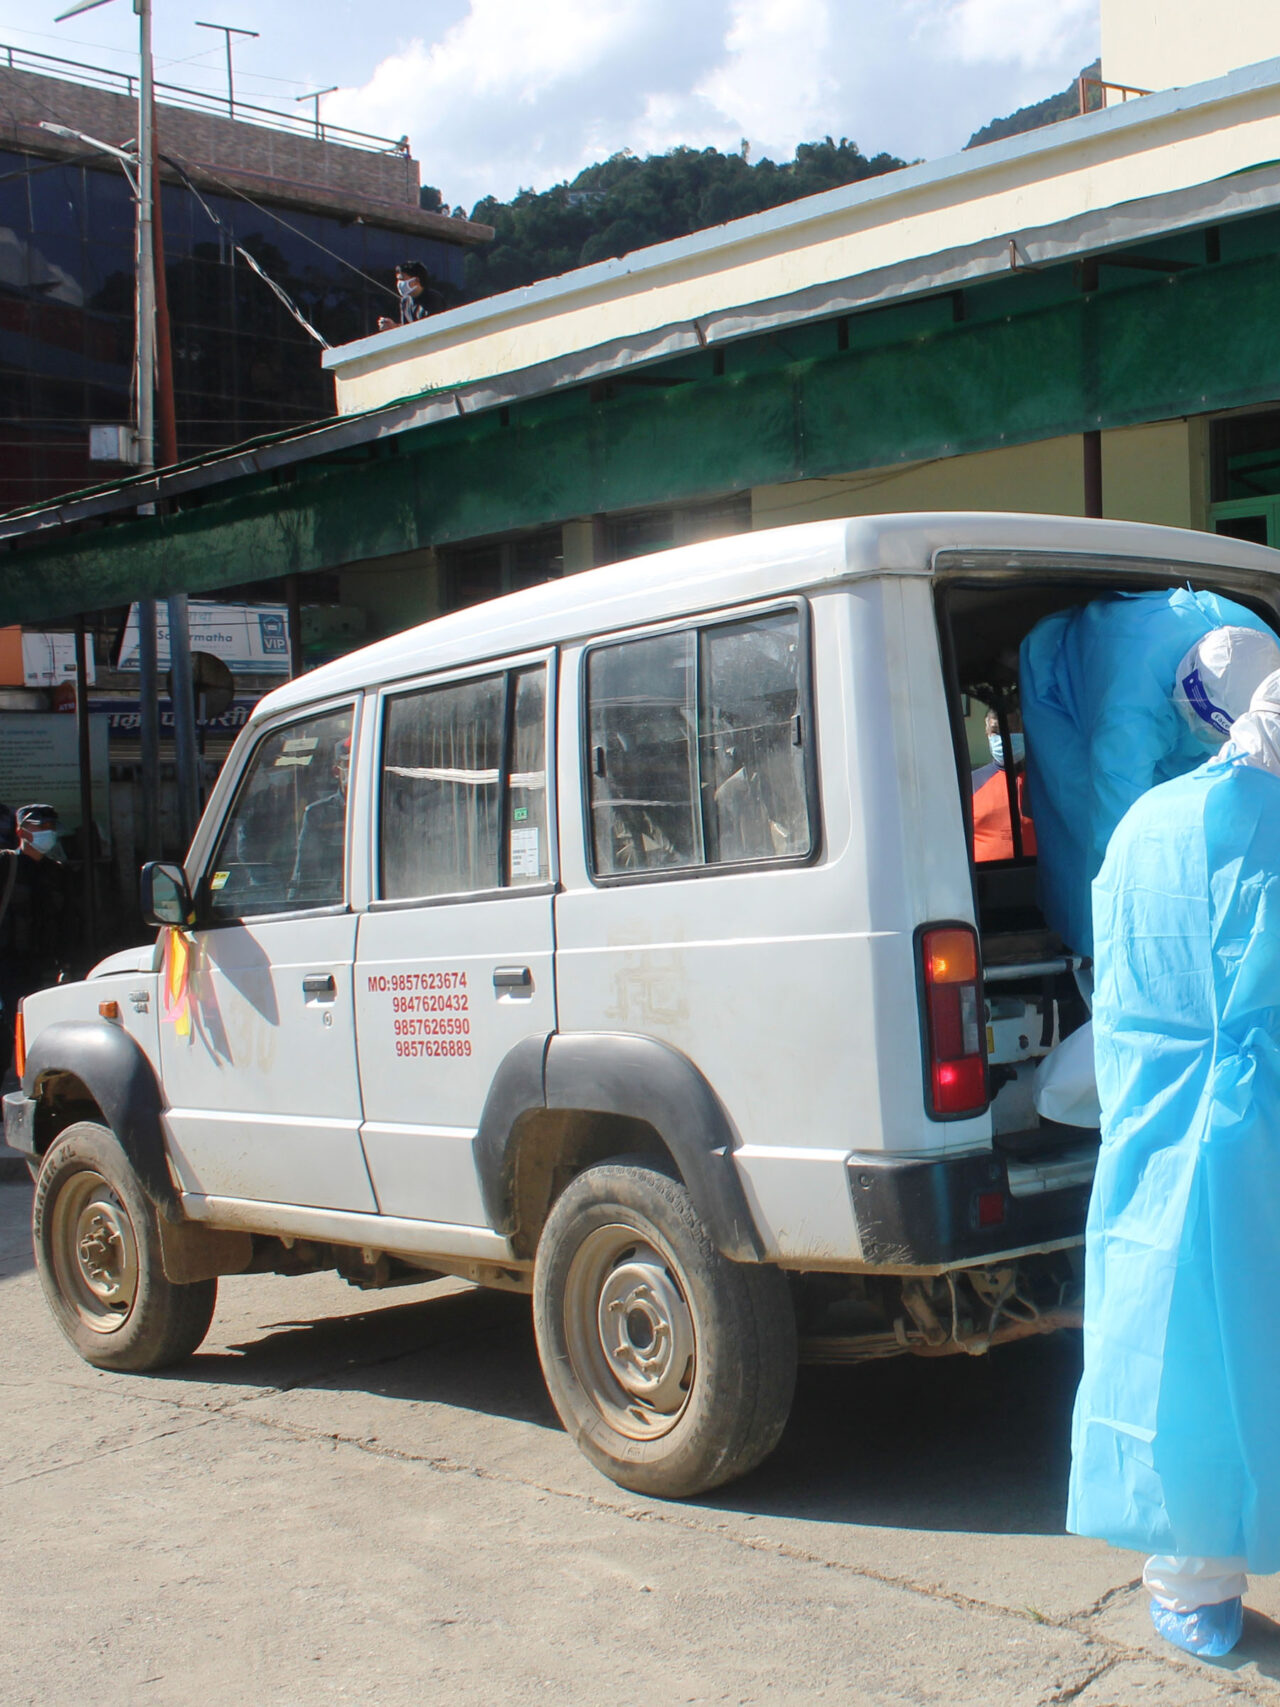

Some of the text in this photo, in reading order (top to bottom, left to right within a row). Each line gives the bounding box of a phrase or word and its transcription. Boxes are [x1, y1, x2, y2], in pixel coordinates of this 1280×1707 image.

[158, 630, 233, 643] Sarmatha
[264, 639, 285, 649] VIP
[368, 972, 467, 992] MO:9857623674
[393, 994, 469, 1013] 9847620432
[394, 1018, 470, 1035] 9857626590
[396, 1040, 472, 1057] 9857626889
